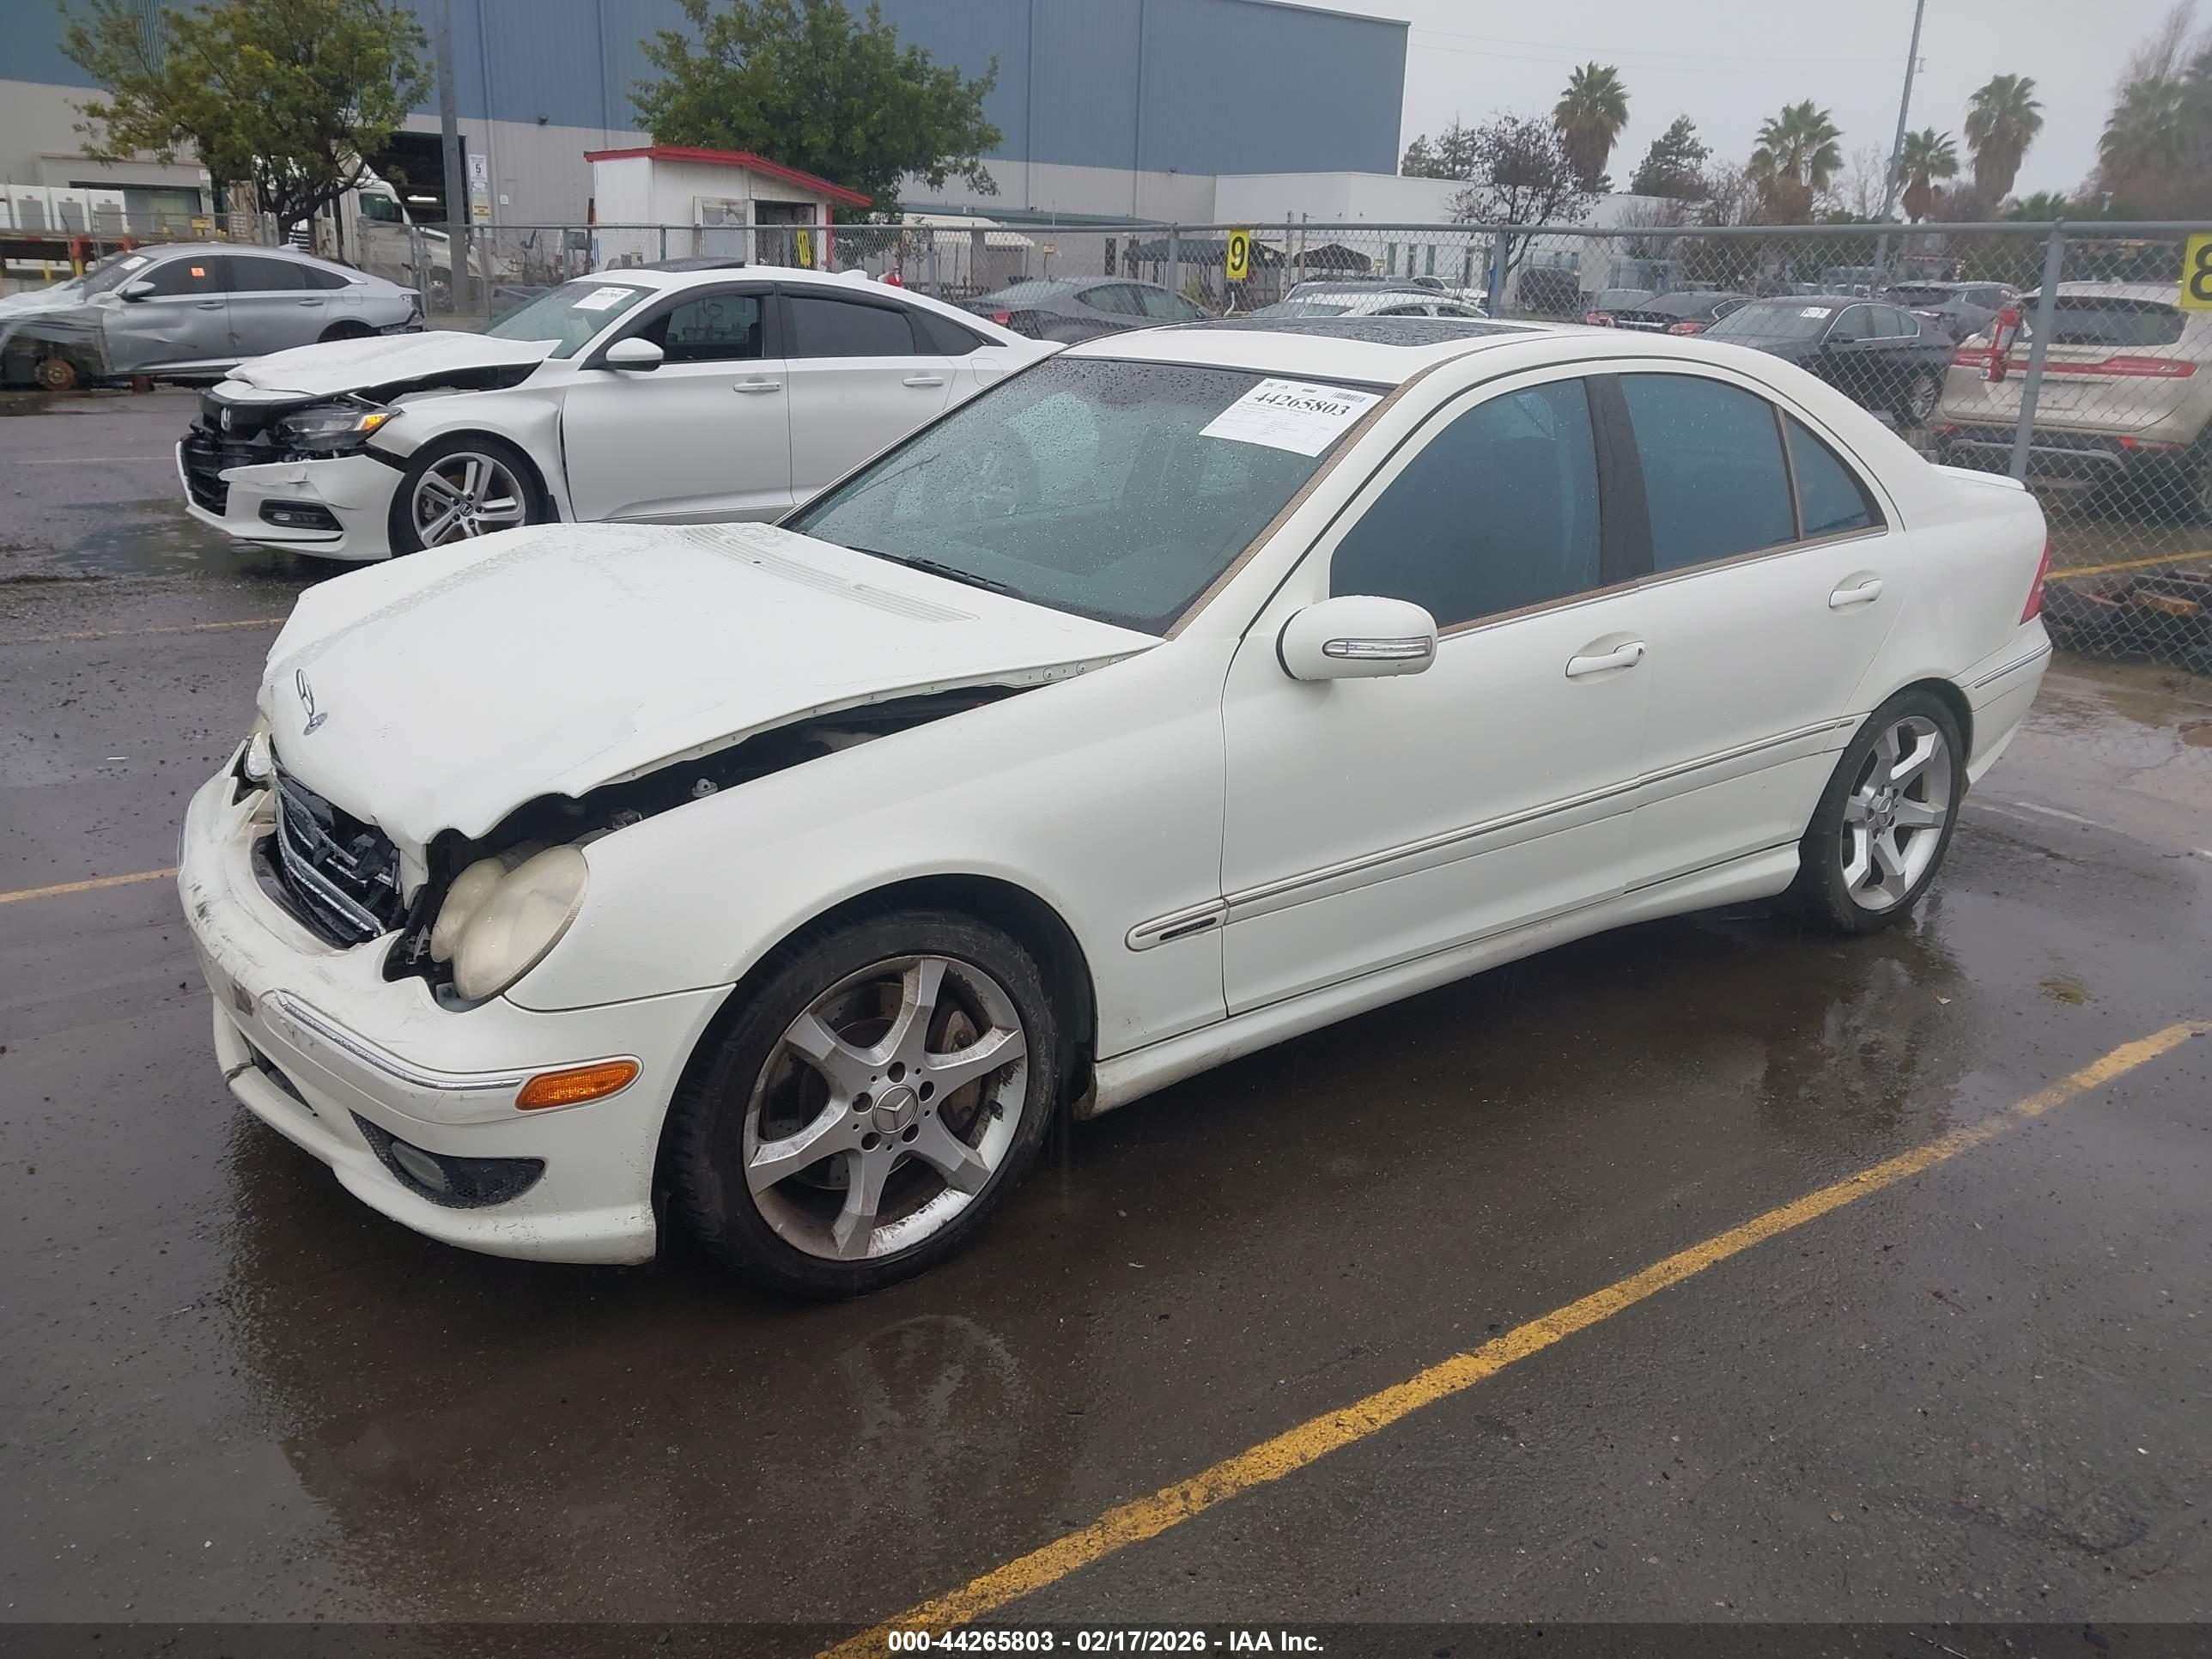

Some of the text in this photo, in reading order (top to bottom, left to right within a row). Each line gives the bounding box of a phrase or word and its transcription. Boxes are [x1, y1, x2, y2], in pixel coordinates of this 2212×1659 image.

[799, 233, 809, 259] 10
[1231, 236, 1245, 271] 9
[1255, 392, 1351, 416] 44265803
